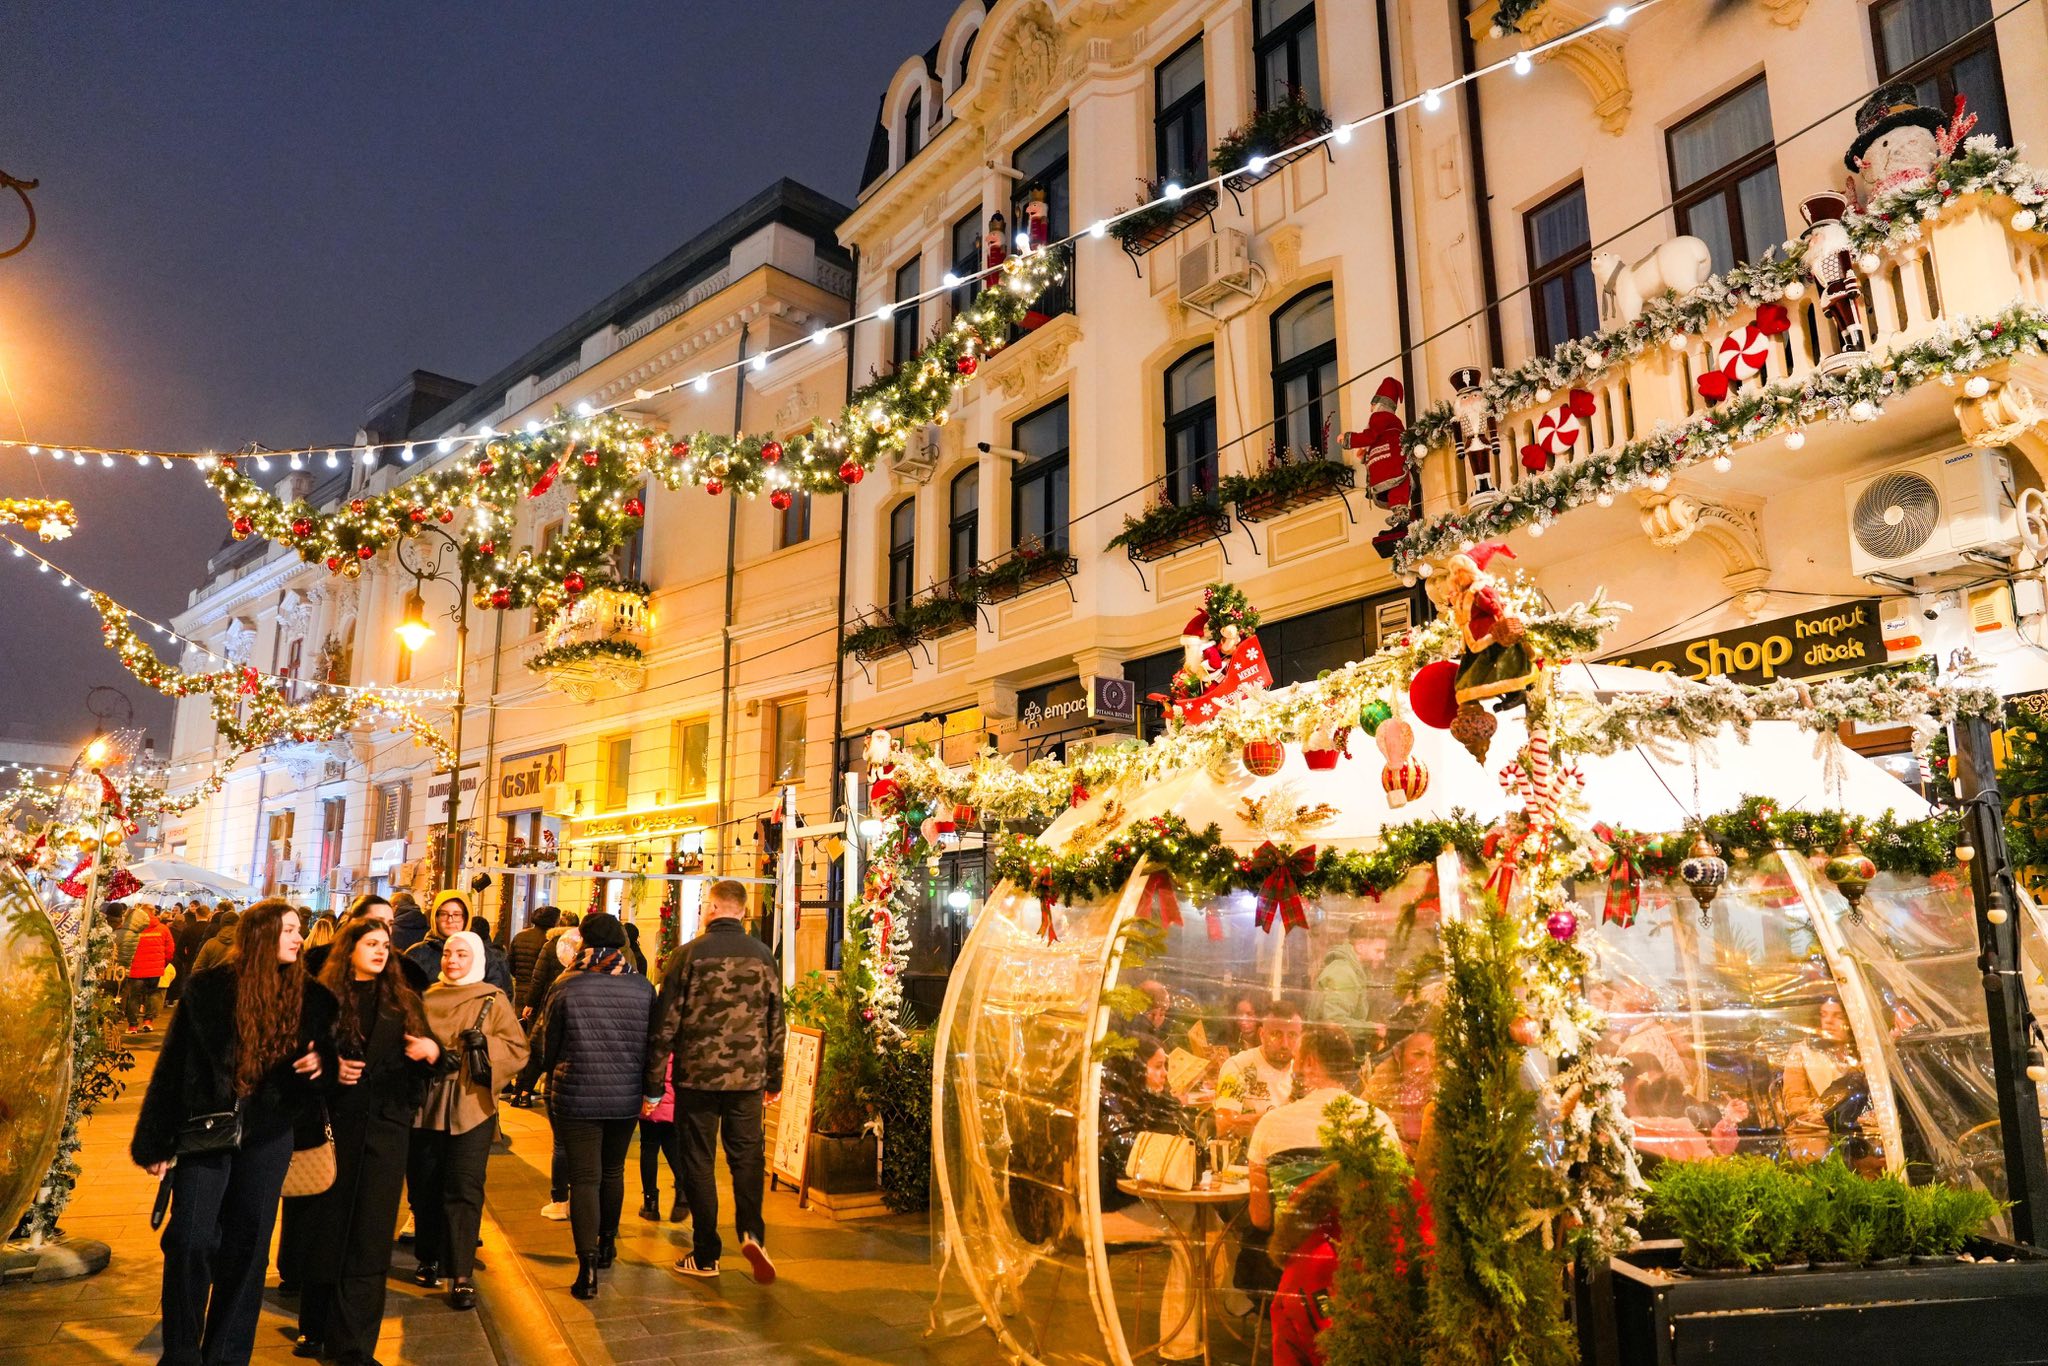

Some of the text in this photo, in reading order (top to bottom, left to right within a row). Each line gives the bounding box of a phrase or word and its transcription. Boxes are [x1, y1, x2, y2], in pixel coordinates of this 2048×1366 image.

[1944, 452, 1973, 465] DAEWOO
[1795, 605, 1868, 639] harput
[1685, 634, 1793, 682] Shop
[1803, 637, 1866, 667] dibek
[1236, 663, 1260, 682] MERRY
[1111, 691, 1118, 699] P
[1096, 708, 1114, 717] PITANA
[501, 769, 541, 799] GSM
